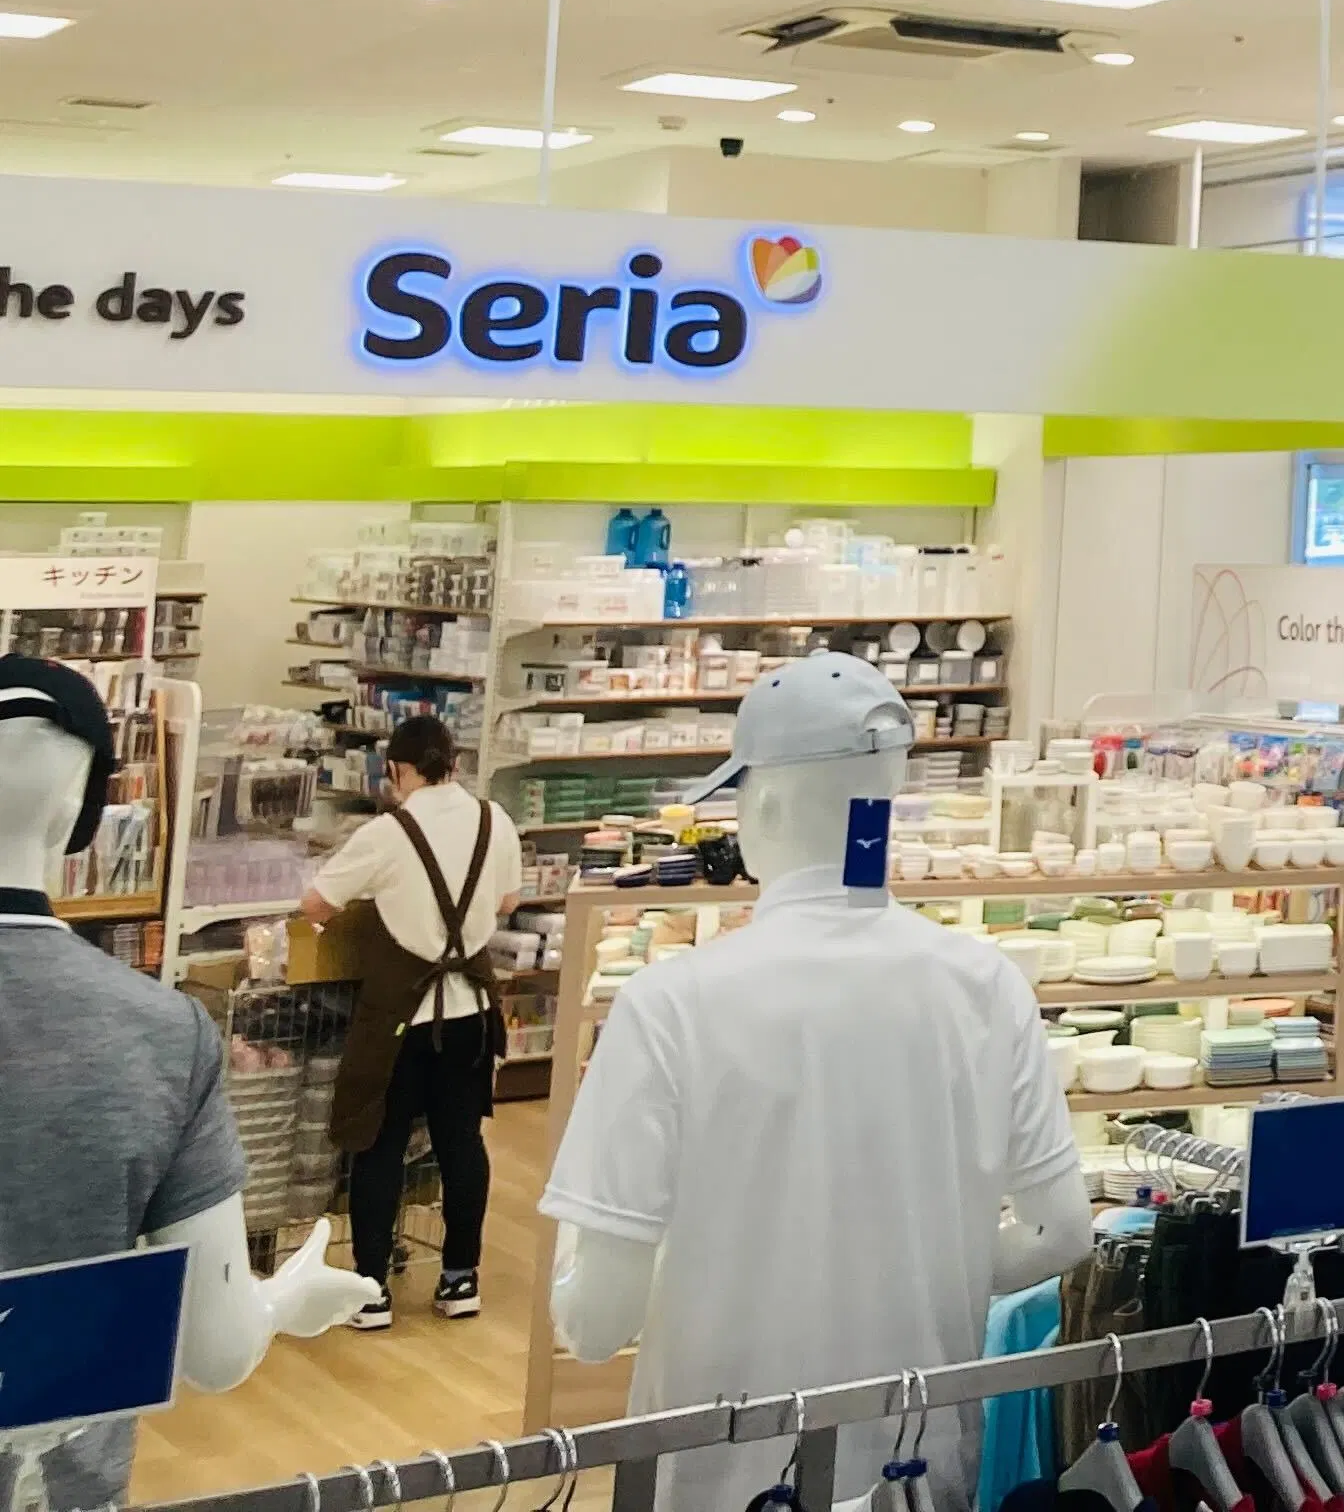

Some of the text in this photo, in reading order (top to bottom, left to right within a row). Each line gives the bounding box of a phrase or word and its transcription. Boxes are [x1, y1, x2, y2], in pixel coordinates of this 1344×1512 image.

[96, 272, 246, 339] days
[363, 252, 748, 368] Seria
[43, 565, 144, 586] キッチン
[1278, 614, 1321, 643] Color
